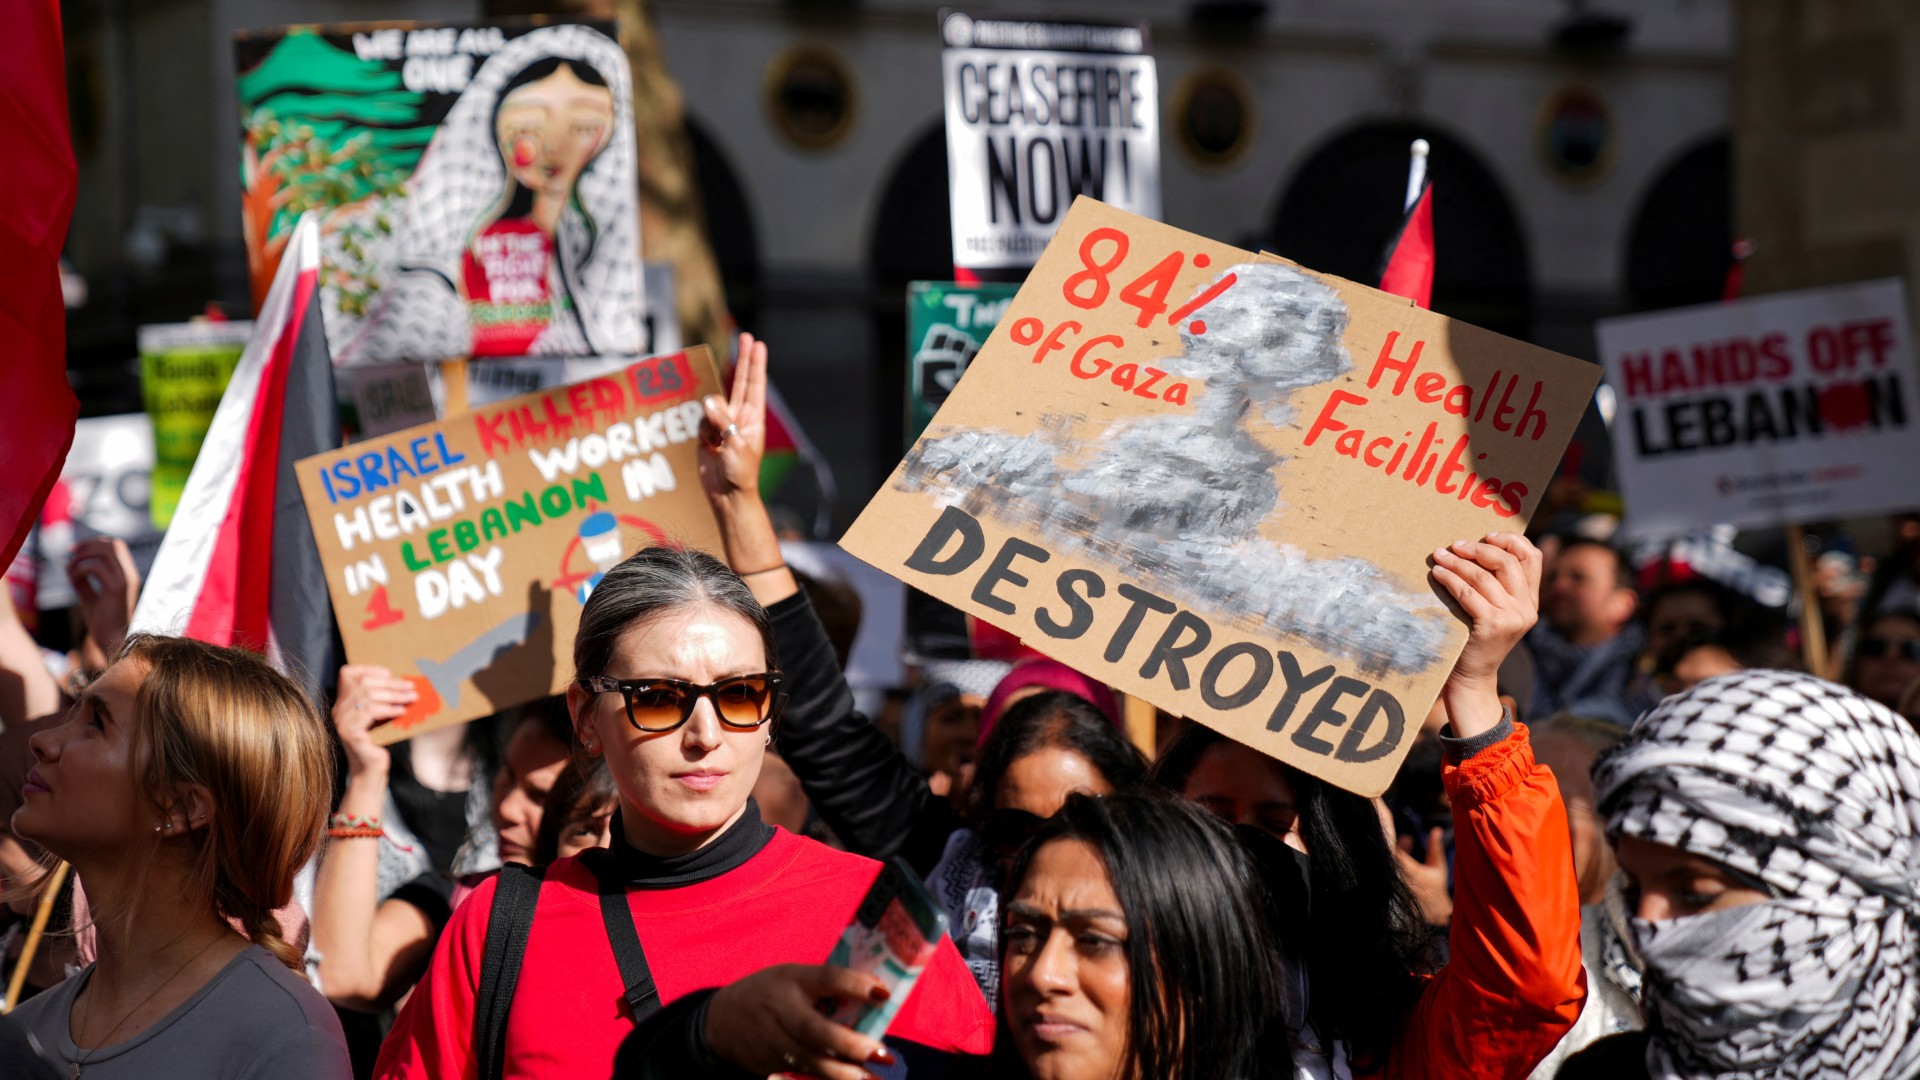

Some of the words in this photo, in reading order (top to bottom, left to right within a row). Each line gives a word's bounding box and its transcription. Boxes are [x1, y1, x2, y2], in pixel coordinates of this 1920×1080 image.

[352, 29, 404, 62] WE
[405, 28, 457, 56] ARE
[457, 27, 506, 55] ALL
[402, 54, 473, 94] ONE
[960, 63, 1142, 129] CEASEFIRE
[986, 134, 1130, 225] NOW!
[1063, 227, 1237, 336] 84%
[1010, 317, 1083, 365] of
[1069, 334, 1189, 406] Gaza
[1366, 330, 1548, 441] Health
[1620, 331, 1793, 397] HANDS
[1807, 317, 1895, 375] OFF
[319, 432, 466, 504] ISRAEL
[474, 376, 626, 458] KILLED
[636, 359, 683, 397] 28
[333, 459, 504, 551] HEALTH
[528, 399, 704, 482] WORKER
[1303, 389, 1529, 518] Facilities
[343, 552, 390, 597] IN
[401, 472, 608, 572] LEBANON
[621, 452, 677, 502] IN
[361, 584, 405, 631] 1
[414, 544, 504, 620] DAY
[903, 504, 1407, 764] DESTROYED
